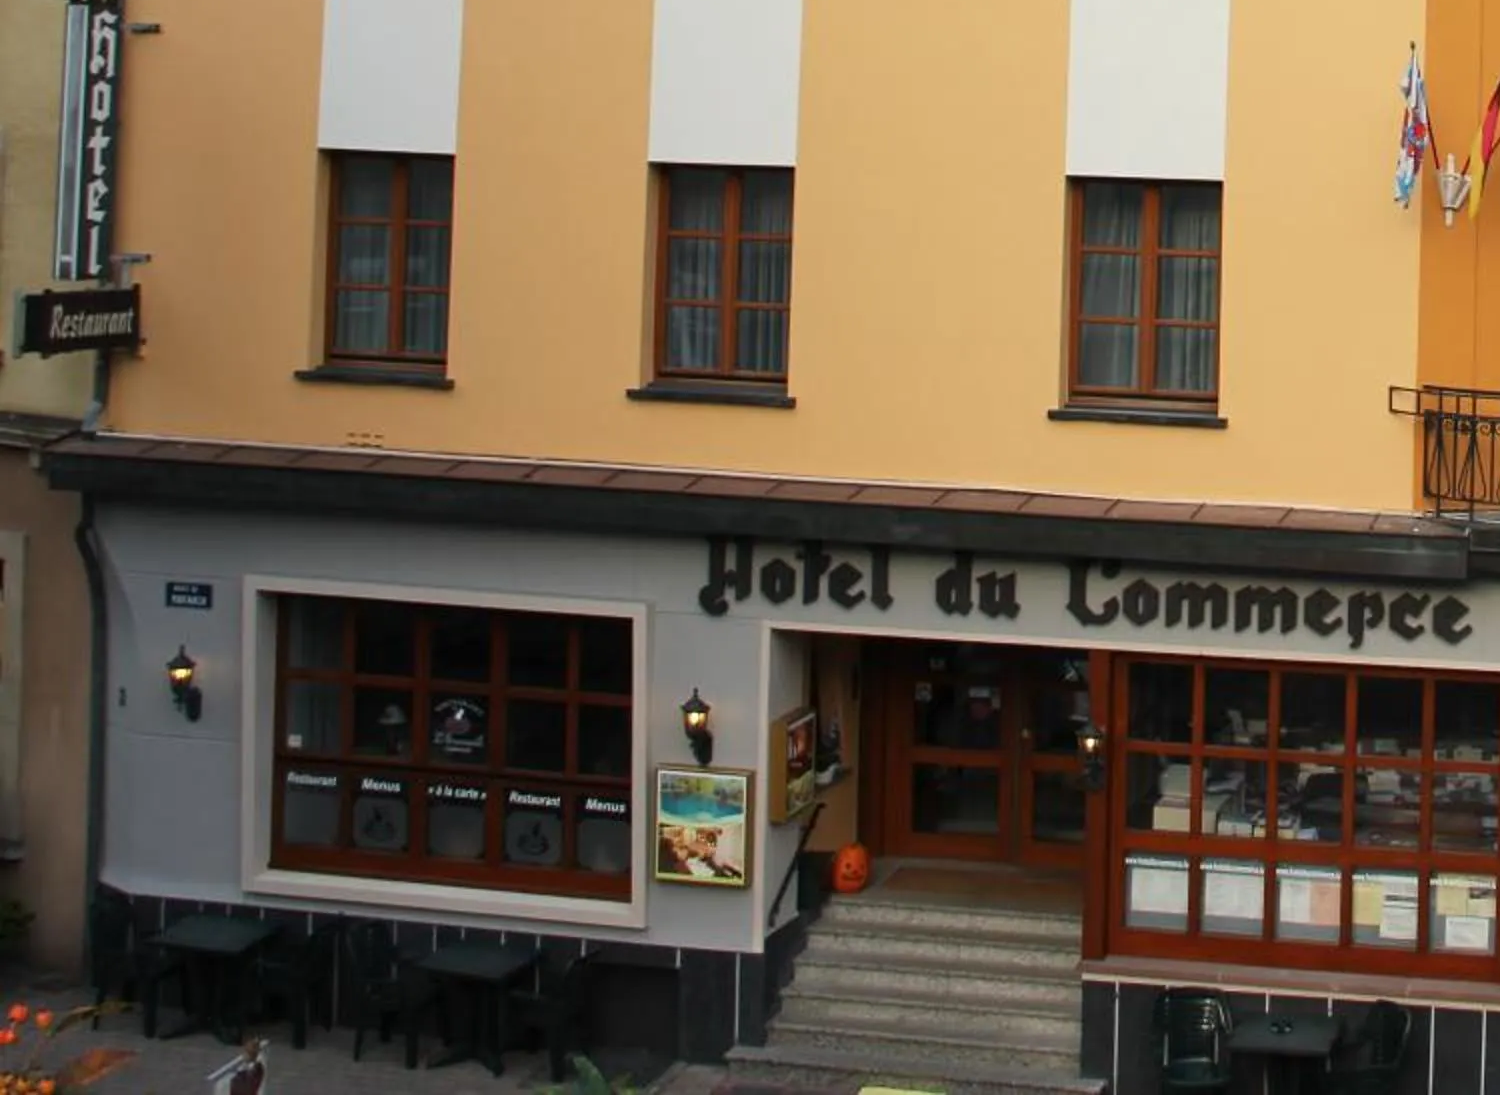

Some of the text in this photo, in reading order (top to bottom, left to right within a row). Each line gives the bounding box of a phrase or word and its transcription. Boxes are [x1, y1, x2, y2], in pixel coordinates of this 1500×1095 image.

[49, 304, 134, 339] Restaurant
[697, 535, 1473, 650] Hotel du Commerce
[287, 771, 337, 786] Restaurant
[361, 777, 401, 792] Menus
[454, 788, 479, 800] carte
[509, 790, 561, 807] Restaurant
[584, 797, 626, 813] Menus
